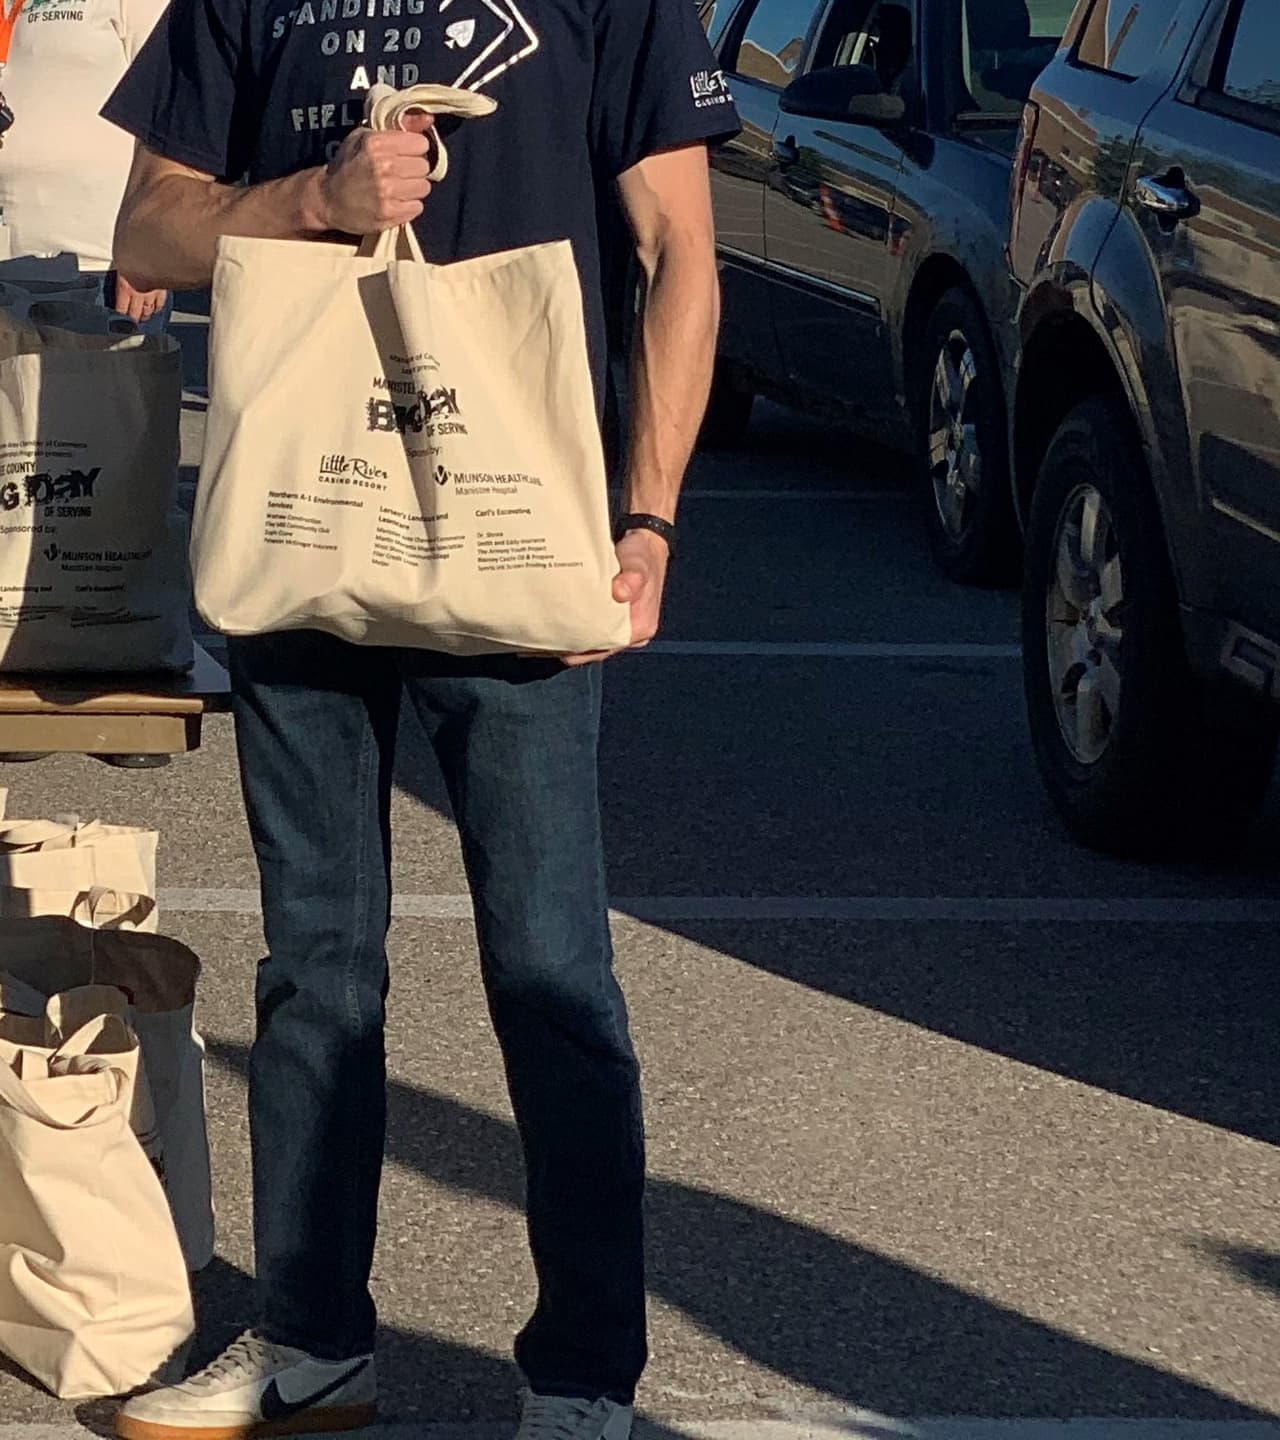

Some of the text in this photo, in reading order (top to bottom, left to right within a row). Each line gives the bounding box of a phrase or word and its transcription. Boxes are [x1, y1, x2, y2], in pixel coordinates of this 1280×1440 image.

[28, 11, 83, 23] OF SERVING
[320, 26, 421, 56] ON 20
[350, 63, 420, 90] AND
[690, 70, 719, 99] Little
[6, 462, 37, 475] COUNTY
[319, 455, 389, 480] Little River
[318, 476, 388, 492] CASINO RESORT
[454, 473, 494, 485] MUNSON
[268, 501, 293, 509] Services
[269, 491, 363, 508] Northern A-1 Environmental
[44, 506, 92, 518] OF SERVING
[475, 509, 496, 517] Carl's
[0, 525, 43, 534] Sponsored
[62, 551, 102, 561] MUNSON
